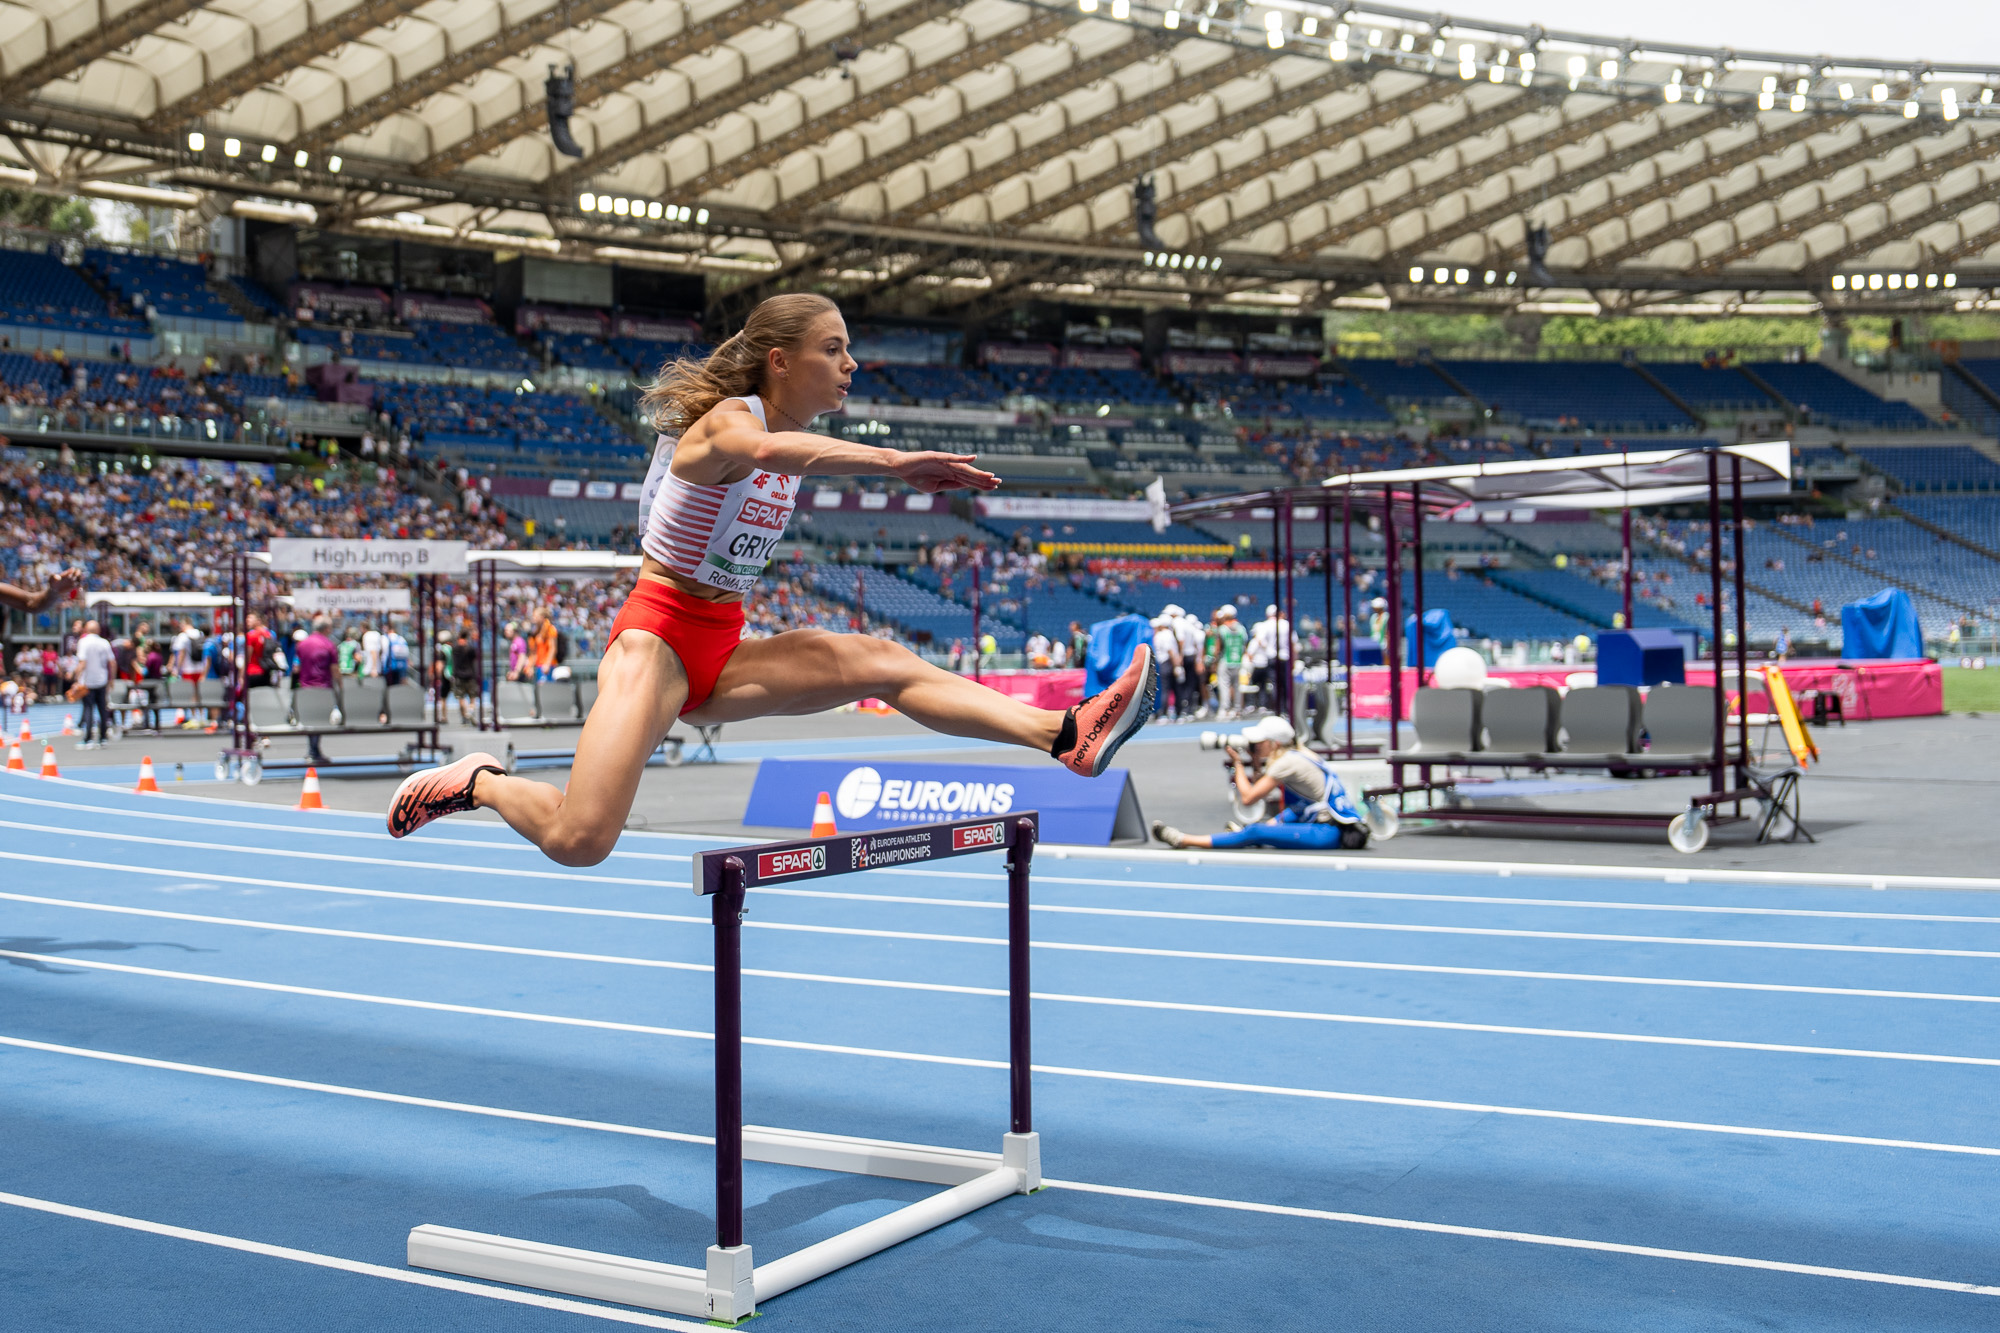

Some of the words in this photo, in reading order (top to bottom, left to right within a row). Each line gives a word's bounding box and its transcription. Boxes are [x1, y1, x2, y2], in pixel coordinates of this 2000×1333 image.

[752, 472, 771, 489] 4F
[770, 490, 788, 501] ORLEN
[741, 501, 791, 527] SPAR
[313, 548, 356, 567] High
[360, 549, 413, 566] Jump
[417, 548, 429, 564] B
[708, 570, 741, 589] ROMA
[1073, 741, 1091, 767] new
[1085, 693, 1122, 742] balance
[879, 780, 1015, 814] EUROINS
[877, 836, 904, 848] EUROPEAN
[905, 832, 931, 844] ATHLETICS
[963, 828, 994, 845] SPAR
[772, 855, 811, 873] SPAR
[870, 845, 931, 866] CHAMPIONSHIPS
